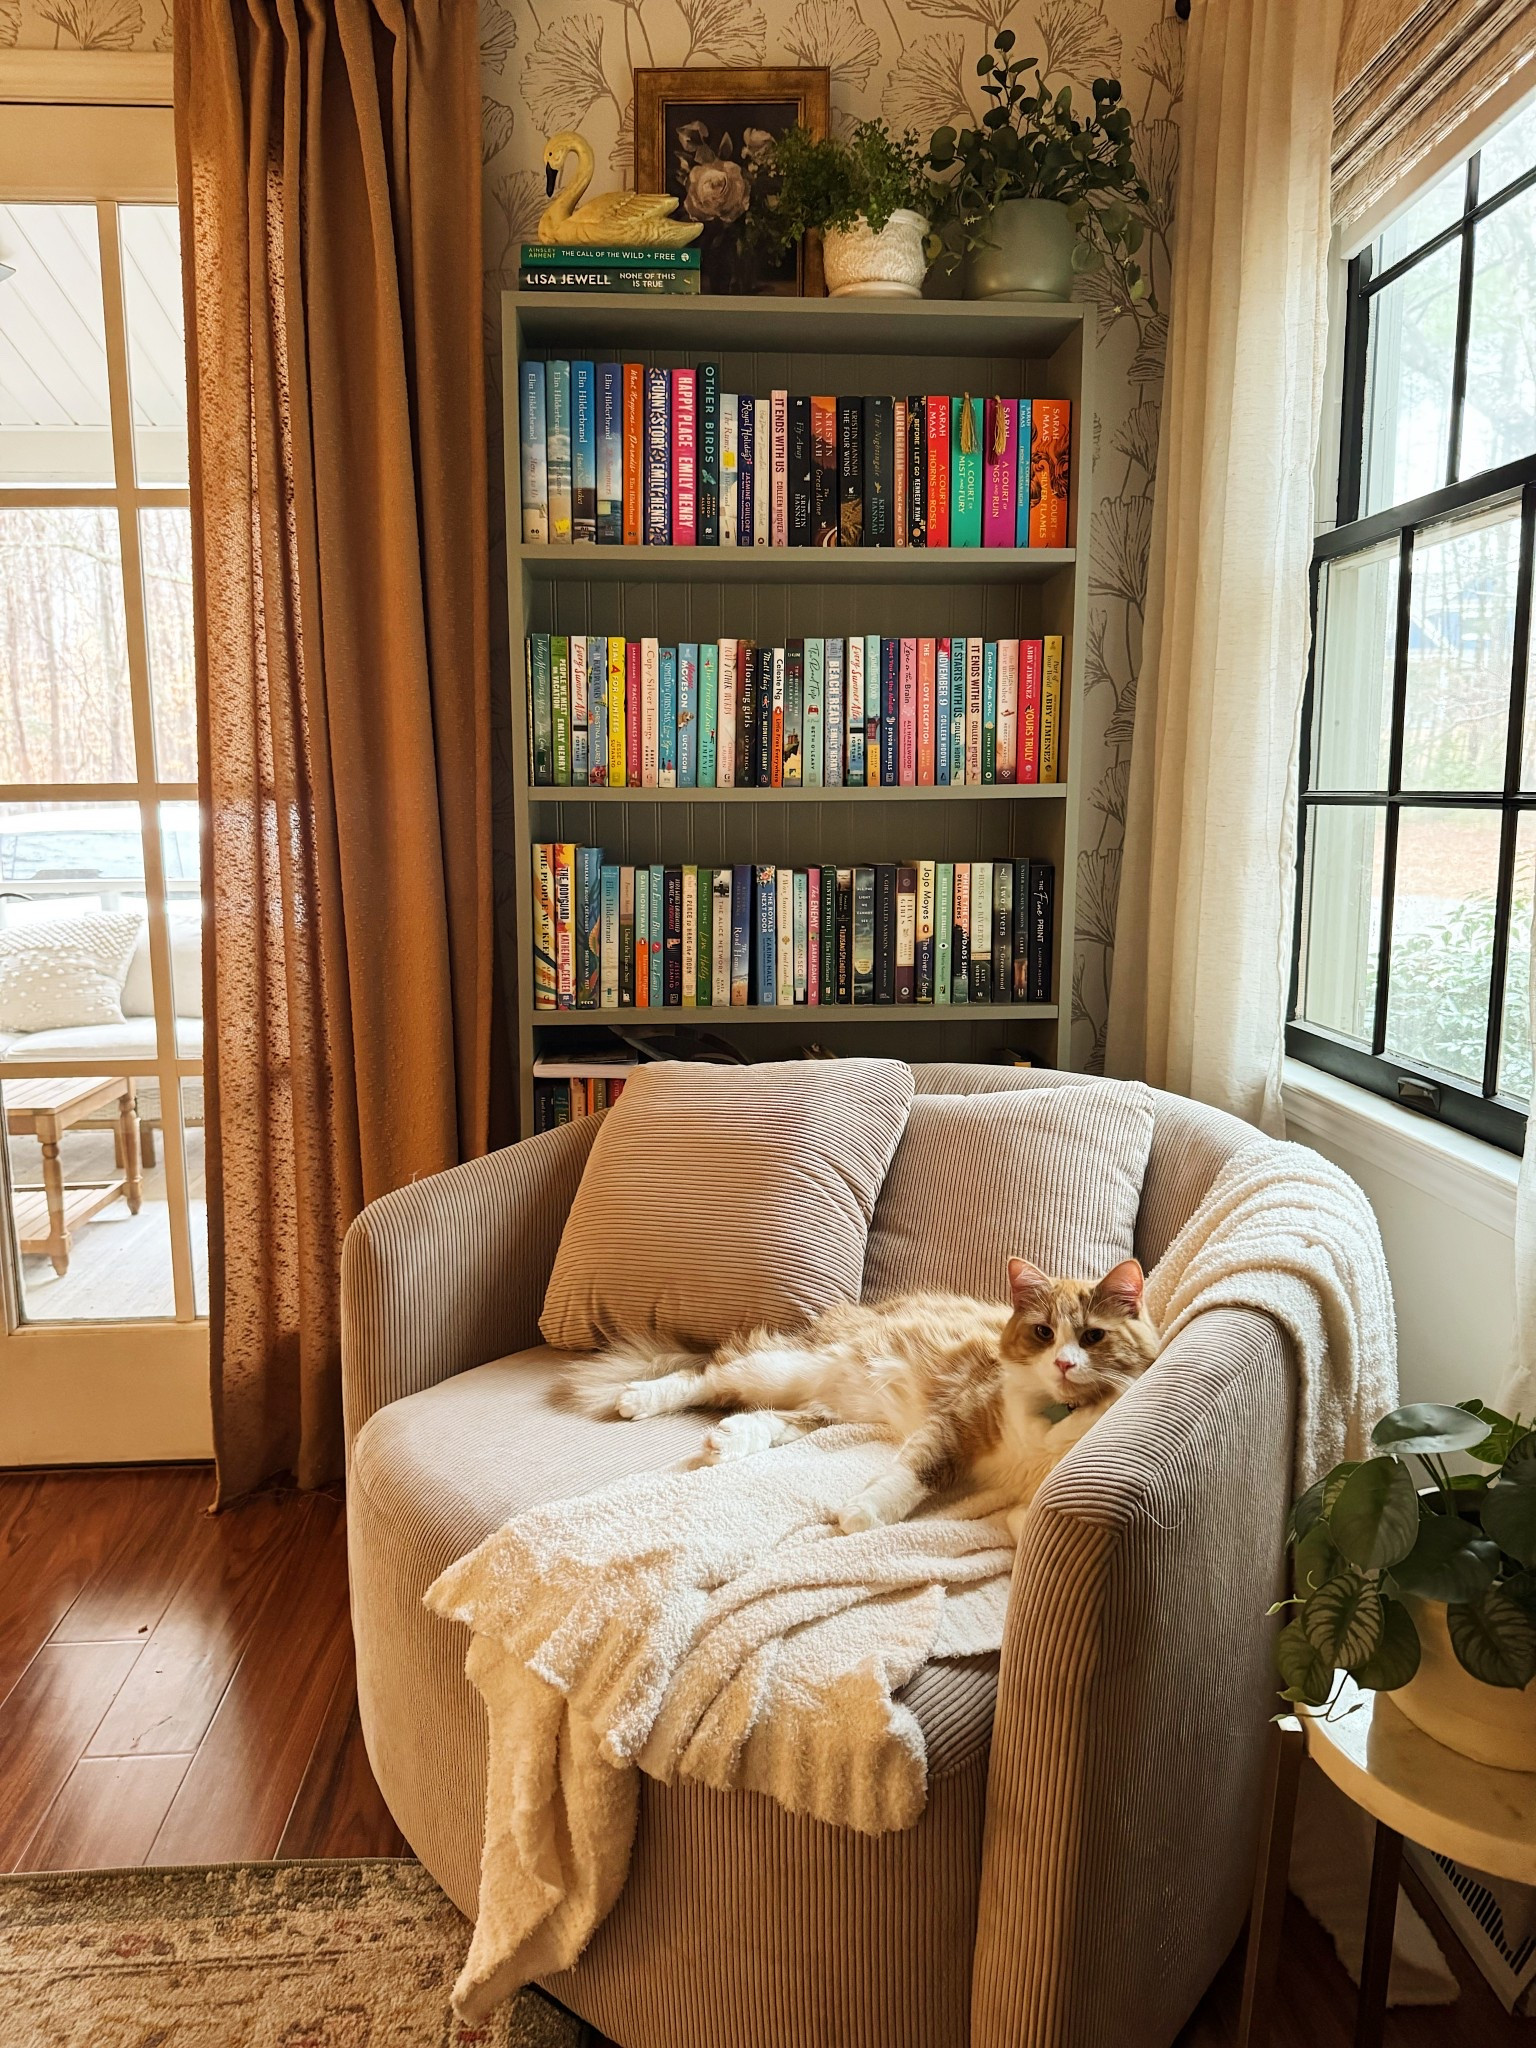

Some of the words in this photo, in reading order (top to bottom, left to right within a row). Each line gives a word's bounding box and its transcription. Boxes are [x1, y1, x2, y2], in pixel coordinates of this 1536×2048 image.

[527, 274, 556, 284] LISA
[561, 275, 611, 285] JEWELL
[528, 374, 536, 389] Elin
[578, 371, 586, 388] Elin
[604, 374, 612, 389] Elin
[705, 367, 714, 413] OTHER
[652, 380, 665, 413] FUNNY
[679, 377, 692, 411] HAPPY
[528, 392, 536, 439] Hilderbrand
[579, 390, 587, 442] Hilderbrand
[604, 392, 612, 440] Hilderbrand
[741, 401, 752, 426] Royal
[775, 410, 784, 433] ENDS
[1052, 408, 1060, 440] SARAH
[651, 419, 665, 450] STORY
[679, 415, 692, 447] PLACE
[794, 422, 803, 433] Fly
[705, 422, 714, 463] BIRDS
[741, 429, 752, 461] Holiday
[775, 436, 784, 458] WITH
[795, 436, 804, 459] Away
[873, 431, 881, 477] Nightingale
[651, 463, 664, 493] EMILY
[679, 457, 692, 488] EMILY
[775, 461, 784, 473] US
[651, 499, 665, 528] HENRY
[679, 493, 693, 528] HENRY
[574, 644, 585, 668] Every
[954, 642, 962, 650] IT
[972, 645, 979, 653] IT
[611, 665, 620, 674] A
[644, 650, 654, 669] Cup
[763, 652, 771, 671] Matt
[954, 652, 962, 681] STARTS
[971, 655, 979, 677] ENDS
[575, 669, 585, 701] Summer
[743, 663, 754, 703] floating
[760, 673, 771, 690] Haig
[829, 661, 839, 695] BEACH
[939, 652, 947, 695] NOVEMBER
[560, 685, 566, 696] WE
[681, 693, 687, 707] ON
[774, 688, 783, 700] Ng
[954, 684, 962, 705] WITH
[971, 679, 979, 700] WITH
[575, 703, 585, 722] After
[829, 698, 839, 724] READ
[953, 707, 962, 718] US
[971, 703, 979, 713] US
[1045, 692, 1053, 717] ABBY
[644, 708, 655, 740] Linings
[742, 706, 753, 728] girls
[1025, 709, 1034, 736] YOURS
[1025, 737, 1034, 761] TRULY
[1044, 719, 1052, 762] JIMENEZ
[559, 869, 569, 880] THE
[923, 868, 932, 887] Jojo
[541, 872, 549, 910] PEOPLE
[558, 884, 569, 919] BODYGUARD
[922, 891, 931, 919] Moyes
[1033, 892, 1048, 916] Fine
[541, 914, 549, 930] WE
[734, 927, 742, 946] Road
[560, 934, 570, 966] KATHERINE
[734, 950, 742, 971] Home
[561, 970, 570, 992] CENTER
